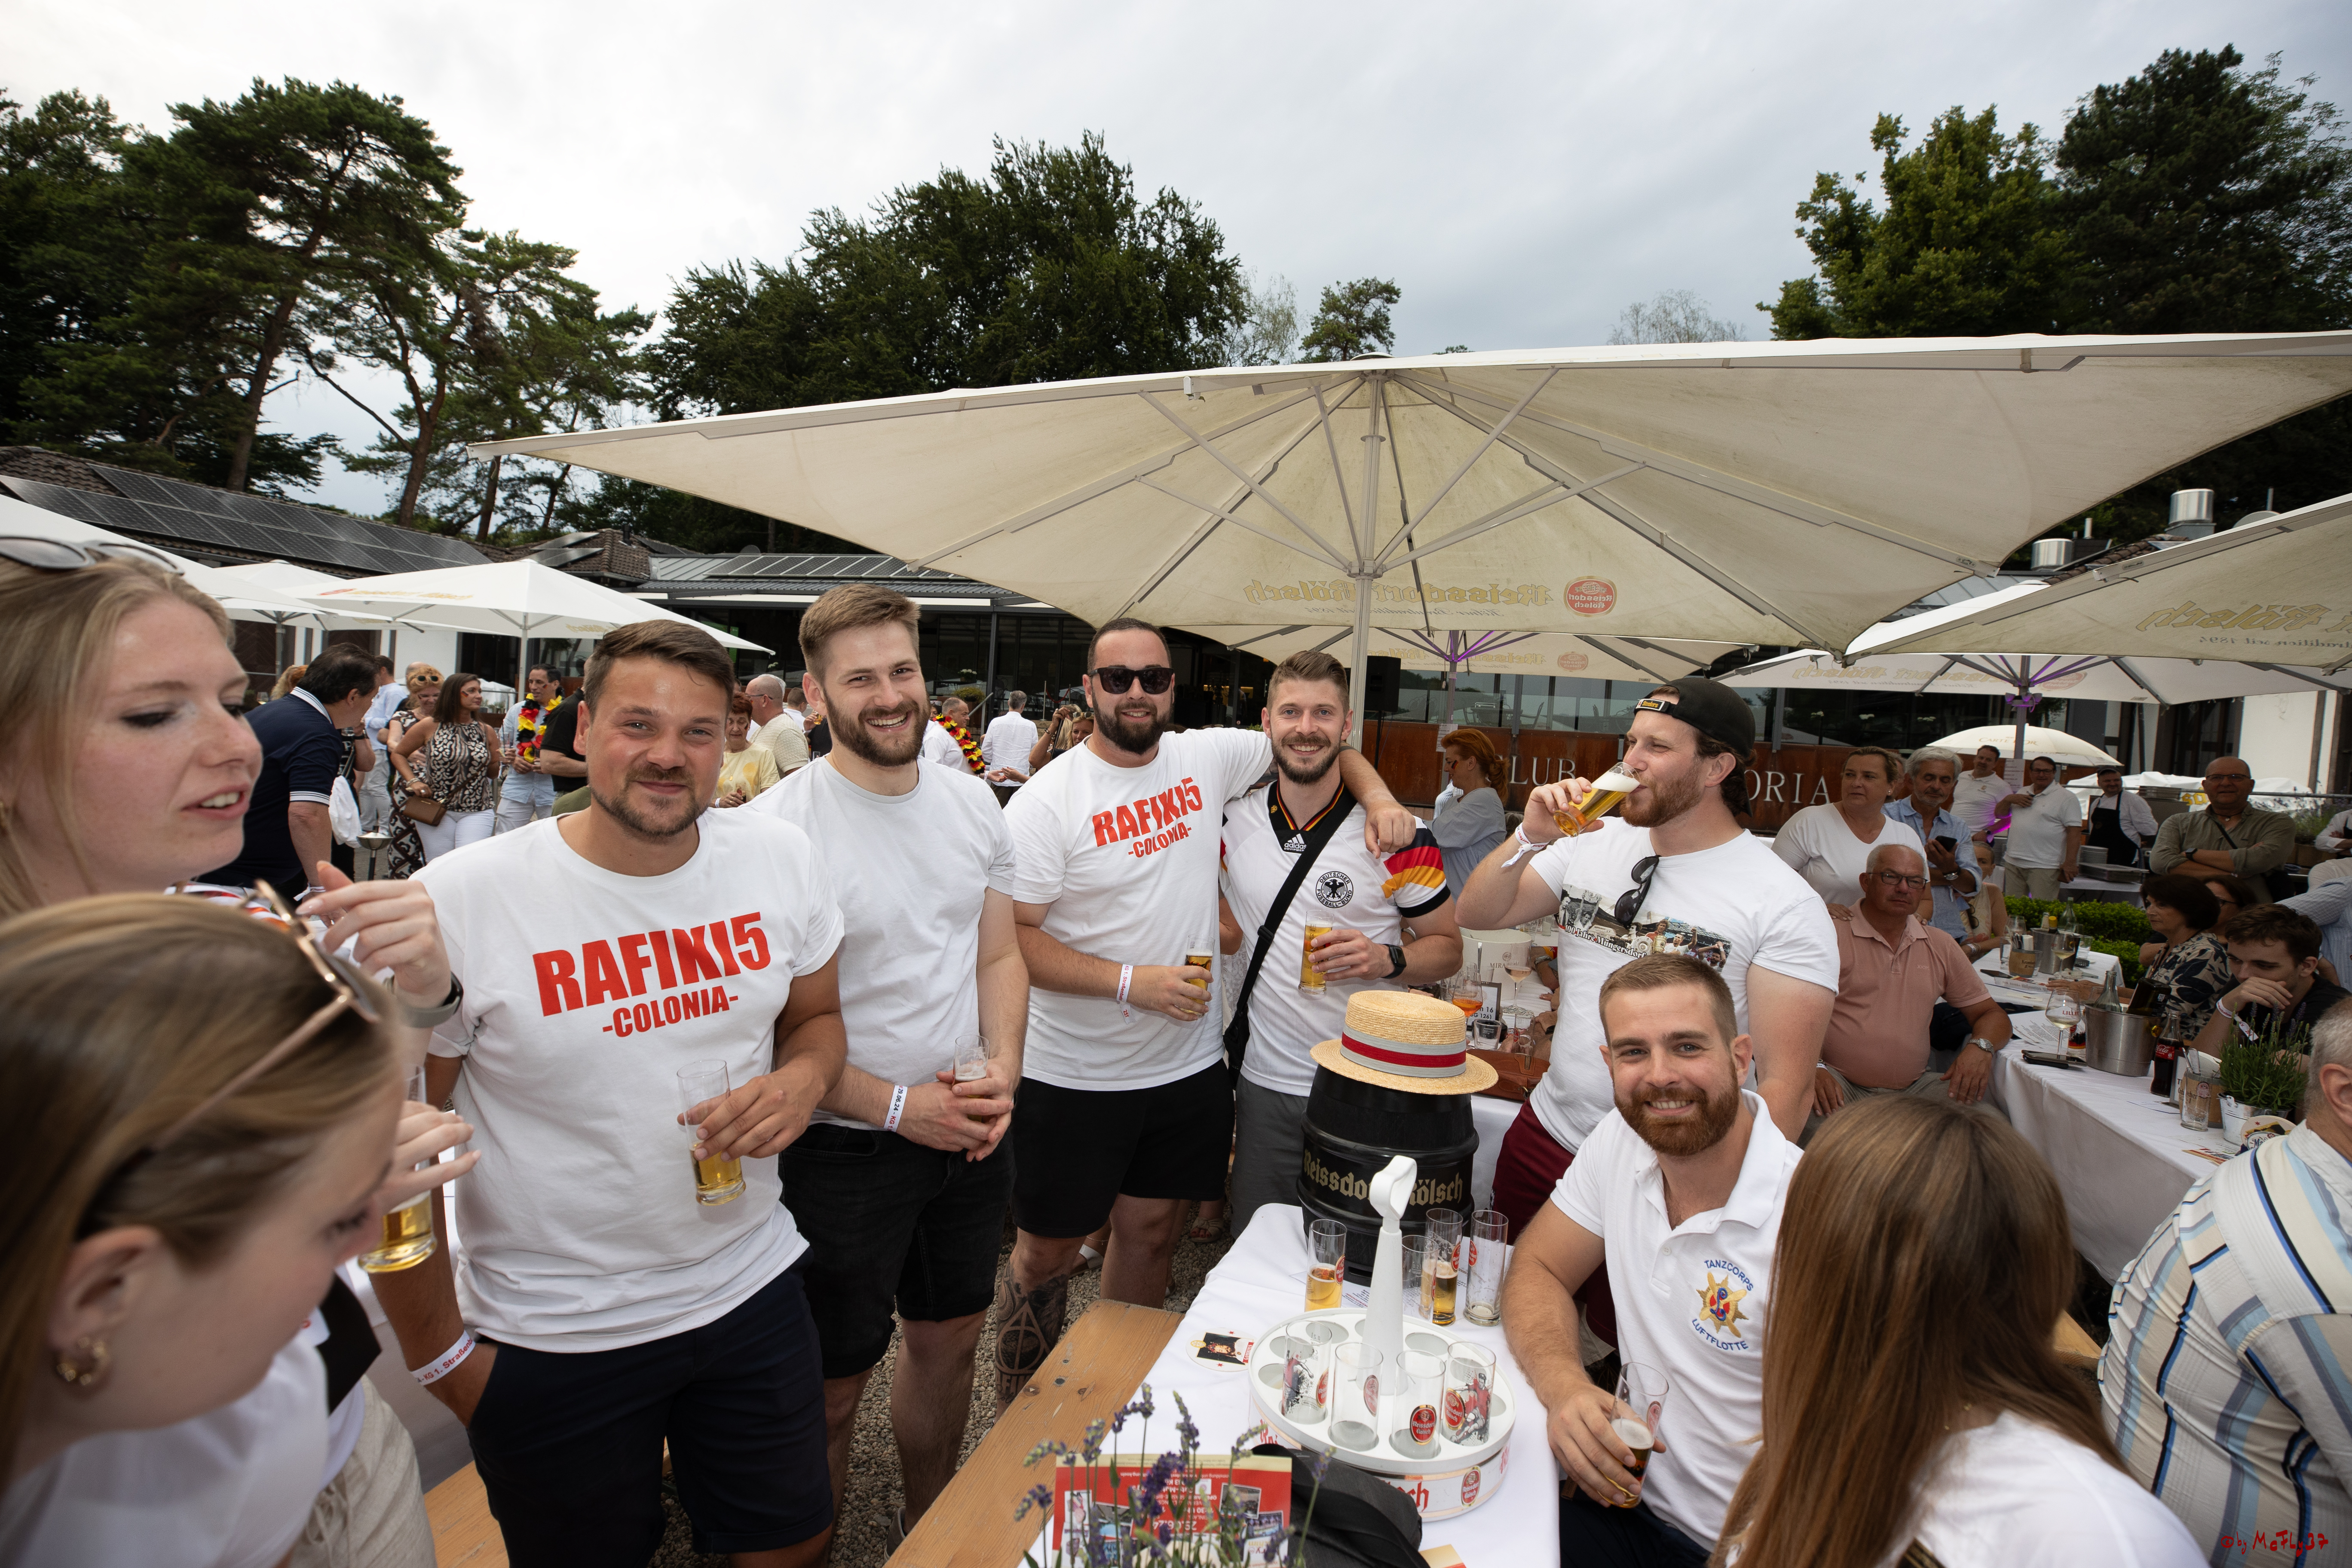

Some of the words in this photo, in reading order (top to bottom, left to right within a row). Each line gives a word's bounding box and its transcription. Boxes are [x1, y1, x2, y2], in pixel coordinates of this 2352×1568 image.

[1485, 754, 1576, 786] LUB
[1092, 777, 1203, 847] RAFIKI5
[1319, 872, 1350, 885] DEUTSCHER
[1317, 889, 1352, 907] FUSSBALL-BUND
[1565, 924, 1575, 934] 100
[1576, 929, 1595, 942] Jahre
[1595, 935, 1647, 959] Müngersdorf
[533, 912, 771, 1017] RAFIKI5
[894, 1088, 903, 1111] 29.06.24
[889, 1115, 896, 1125] KG
[1304, 1149, 1372, 1200] Reissdo
[1704, 1259, 1754, 1291] TANZCORPS
[1692, 1319, 1749, 1351] LUFTFLOTTE
